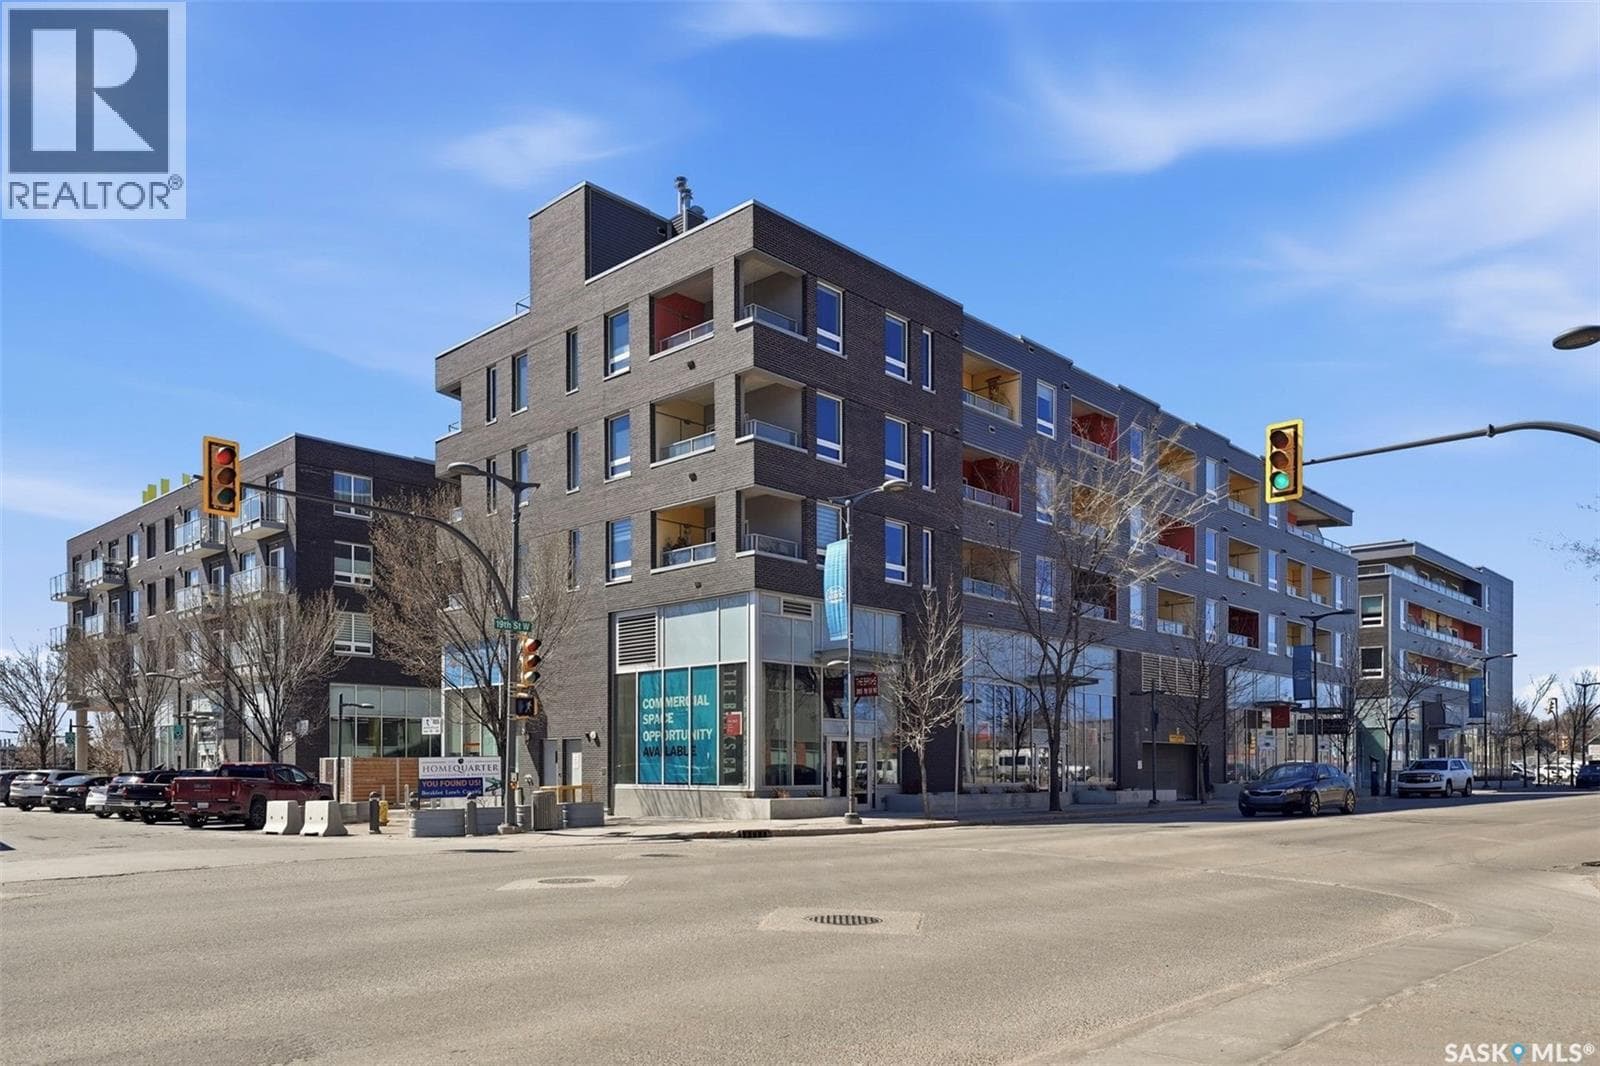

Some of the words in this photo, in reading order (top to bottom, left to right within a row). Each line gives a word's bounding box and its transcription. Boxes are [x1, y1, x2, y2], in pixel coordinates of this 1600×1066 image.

[496, 620, 512, 629] 19th
[512, 621, 521, 630] St
[522, 622, 531, 631] W
[723, 670, 736, 696] THE
[642, 695, 709, 709] COMMERCIAL
[642, 728, 713, 742] OPPORTUNITY
[723, 703, 736, 774] BKS.CA
[643, 745, 697, 757] AVALABLE
[422, 763, 499, 773] HOMEQUARTER
[440, 779, 468, 787] FOUND
[468, 778, 482, 786] US!
